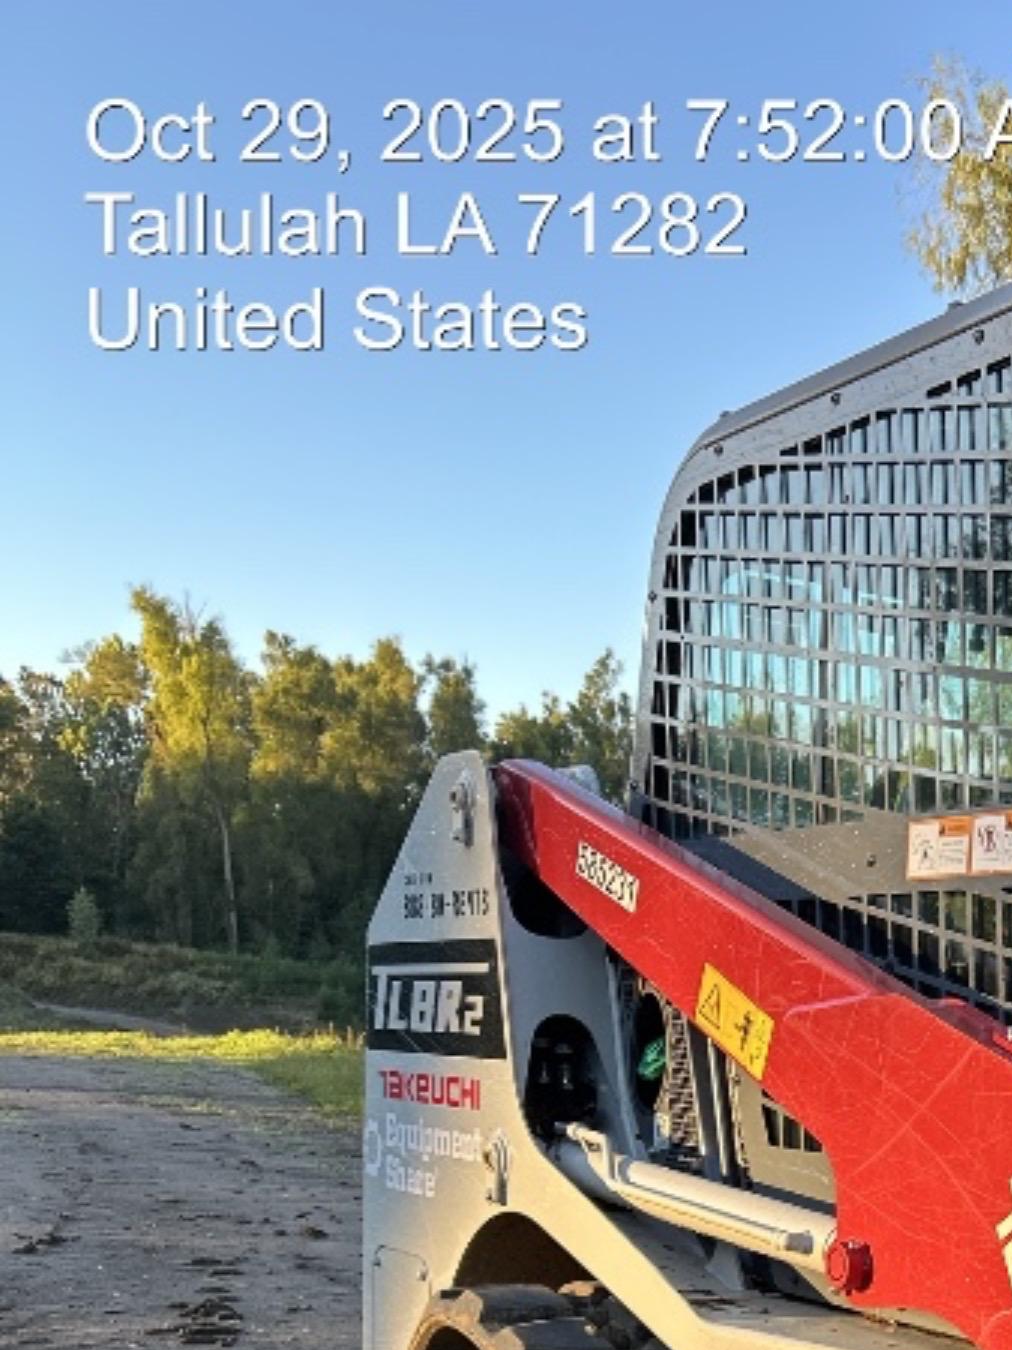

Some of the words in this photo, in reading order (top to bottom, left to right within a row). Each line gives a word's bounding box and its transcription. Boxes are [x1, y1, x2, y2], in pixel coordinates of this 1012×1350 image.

[371, 962, 490, 1037] TL8R2
[385, 1112, 483, 1163] Equipment
[385, 1153, 437, 1198] Share
